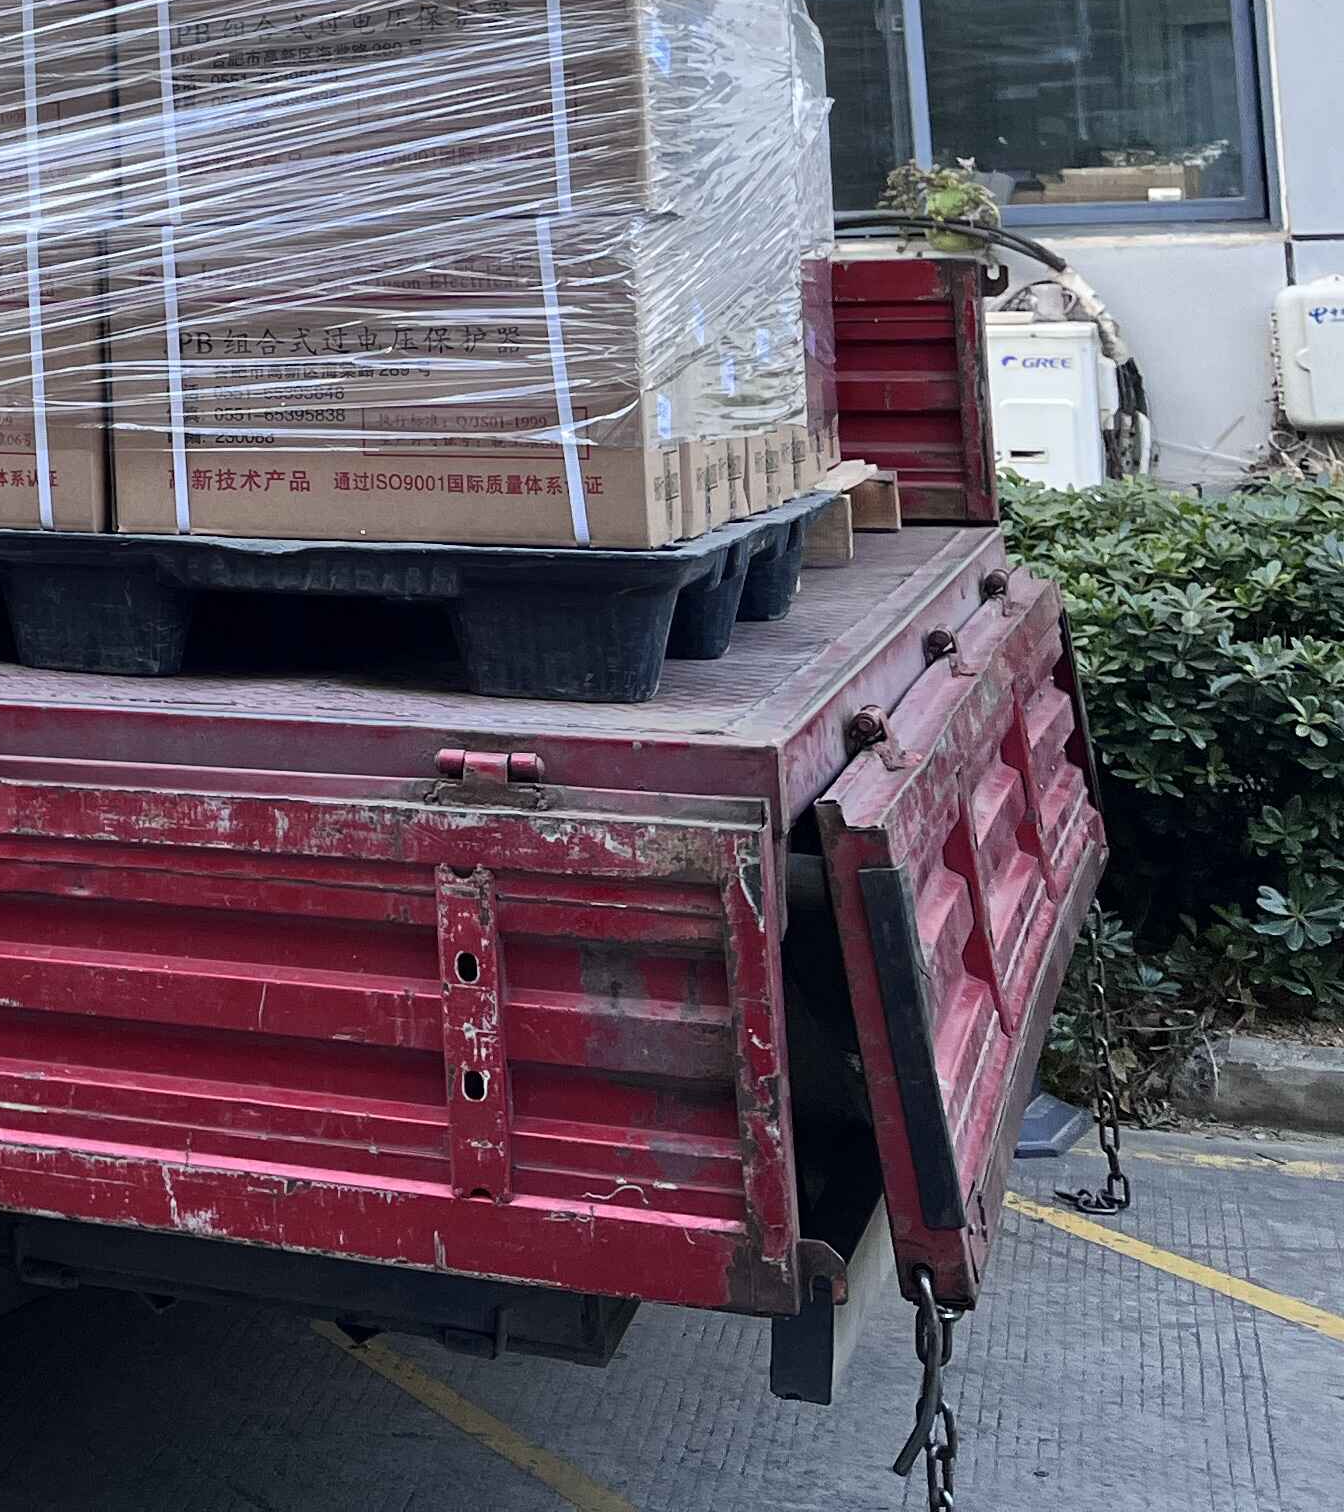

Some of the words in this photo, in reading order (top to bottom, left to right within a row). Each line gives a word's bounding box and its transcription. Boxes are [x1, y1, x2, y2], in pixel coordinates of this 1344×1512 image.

[1022, 357, 1072, 369] GREE
[333, 471, 605, 496] 通过ISO9001国际质量体系证
